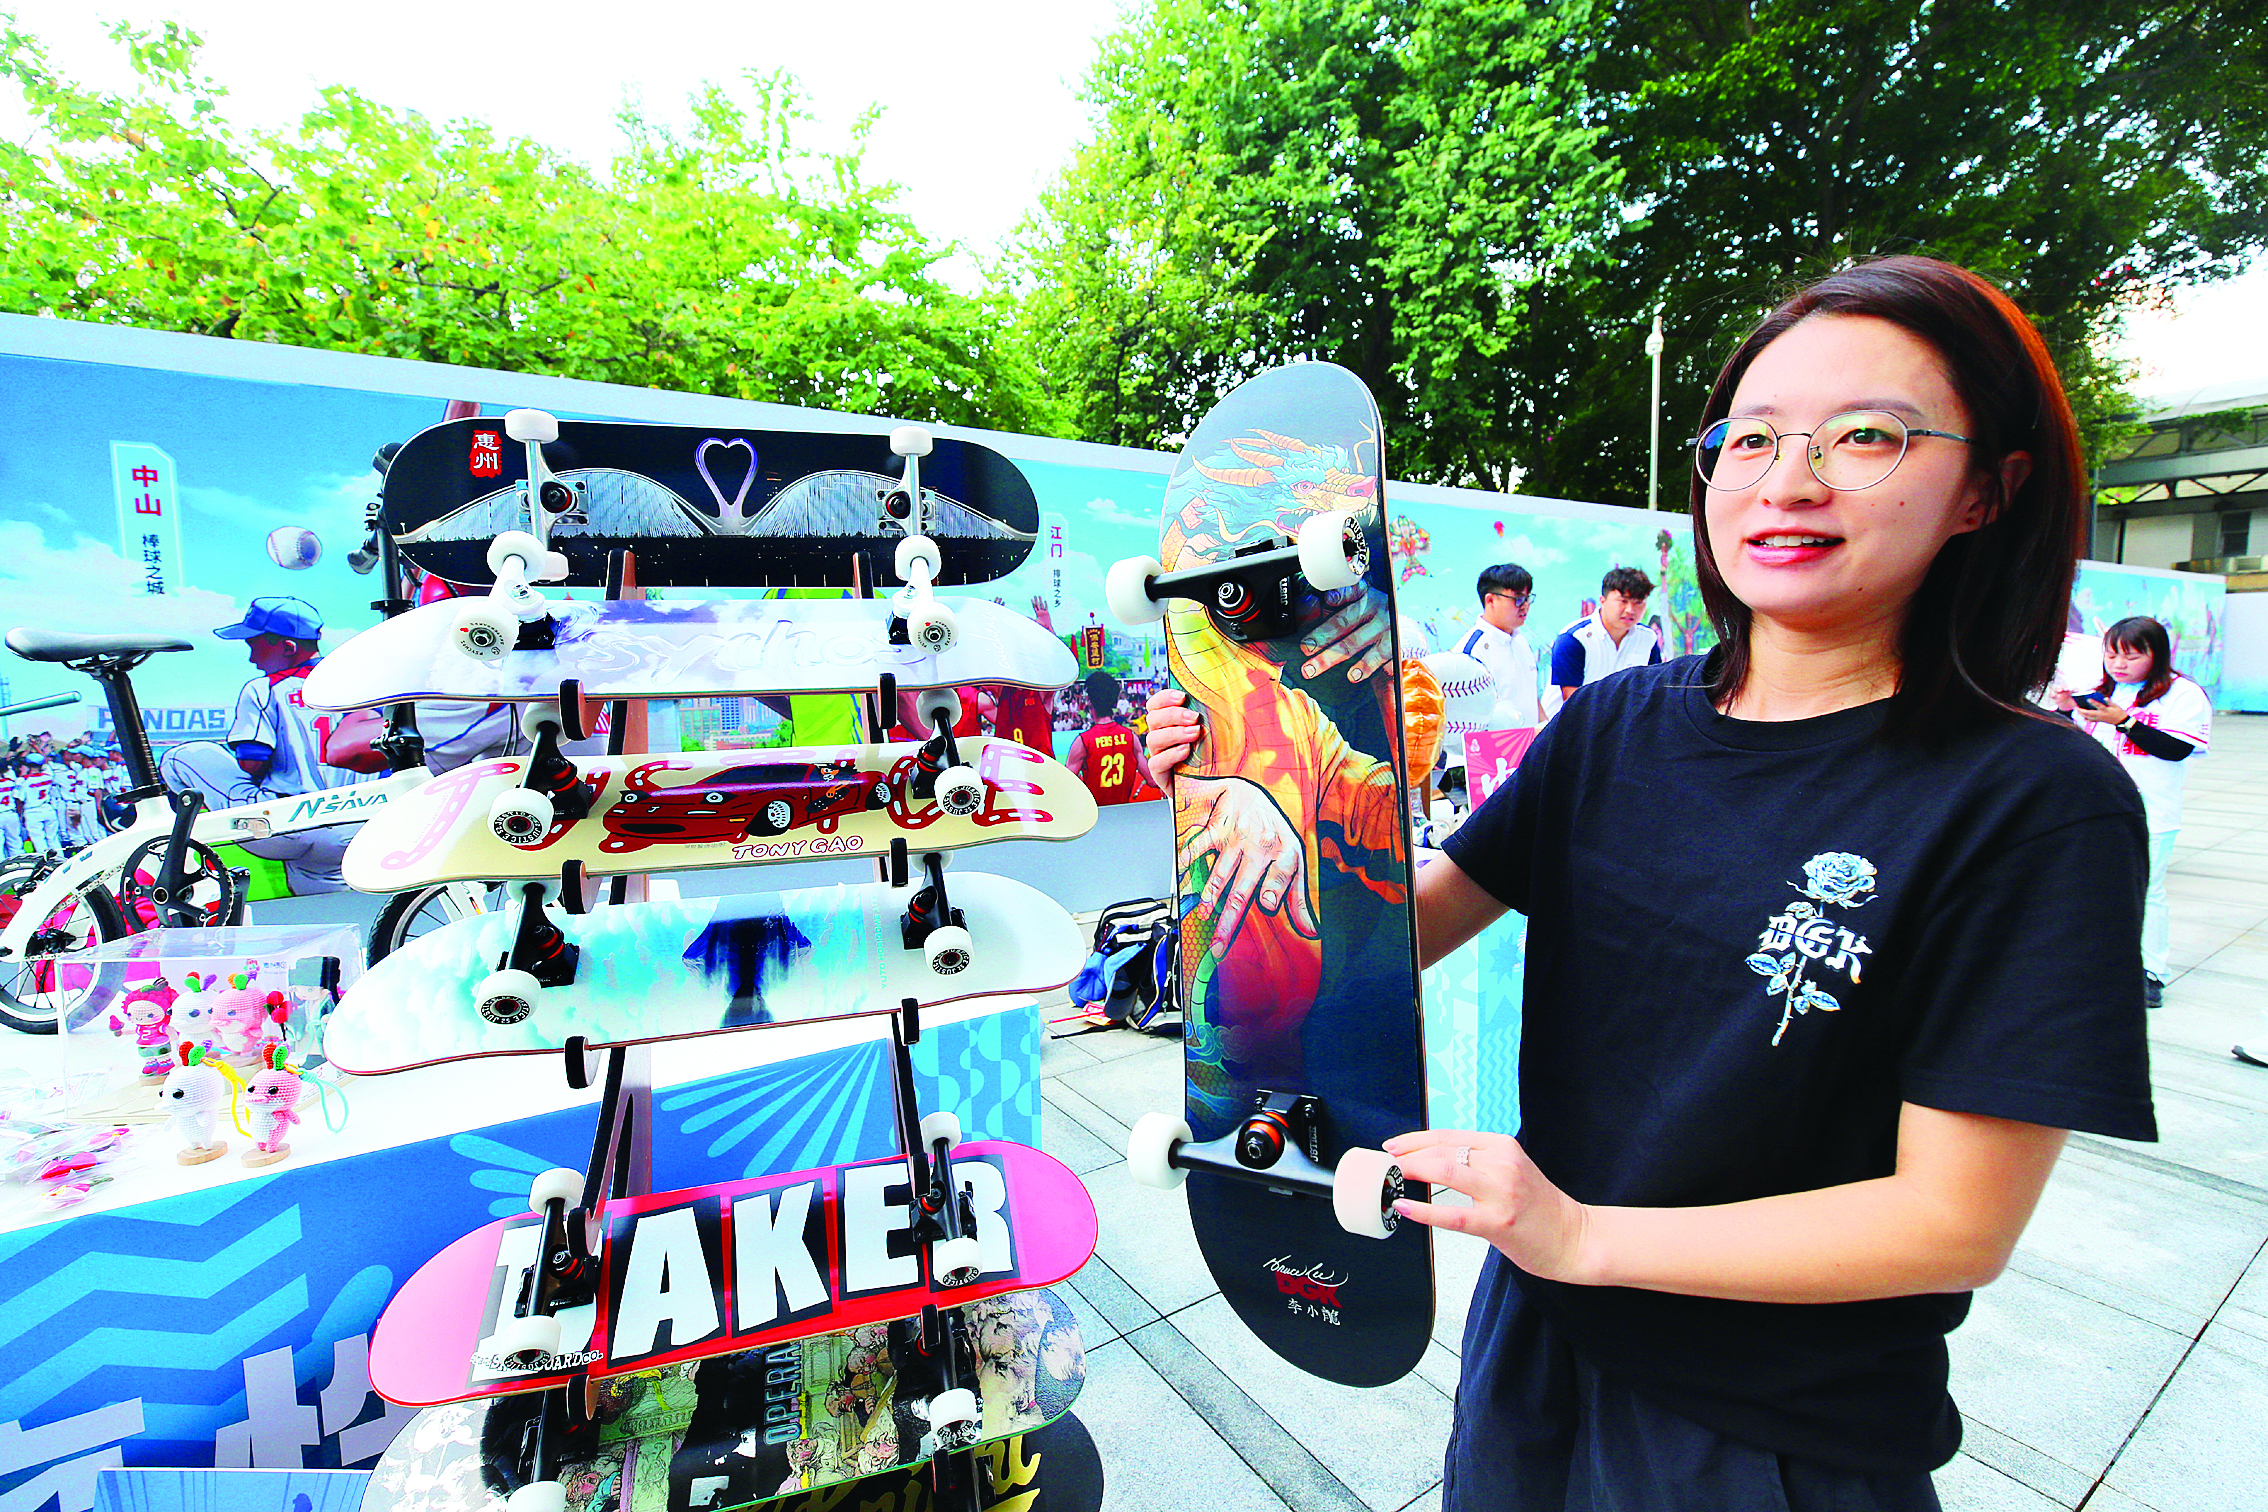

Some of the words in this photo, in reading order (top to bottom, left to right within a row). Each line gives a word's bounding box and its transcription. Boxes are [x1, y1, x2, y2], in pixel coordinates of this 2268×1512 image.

[473, 433, 500, 471] 惠州
[132, 465, 162, 516] 中山
[1050, 526, 1063, 558] 江门
[142, 533, 165, 595] 棒球之城
[98, 706, 226, 730] PNDAS
[1100, 753, 1125, 787] 23
[732, 840, 807, 860] TONY
[809, 835, 864, 854] GAO
[878, 962, 888, 990] YUTO
[1287, 1297, 1341, 1326] 李小龍
[764, 1343, 802, 1445] OPERA
